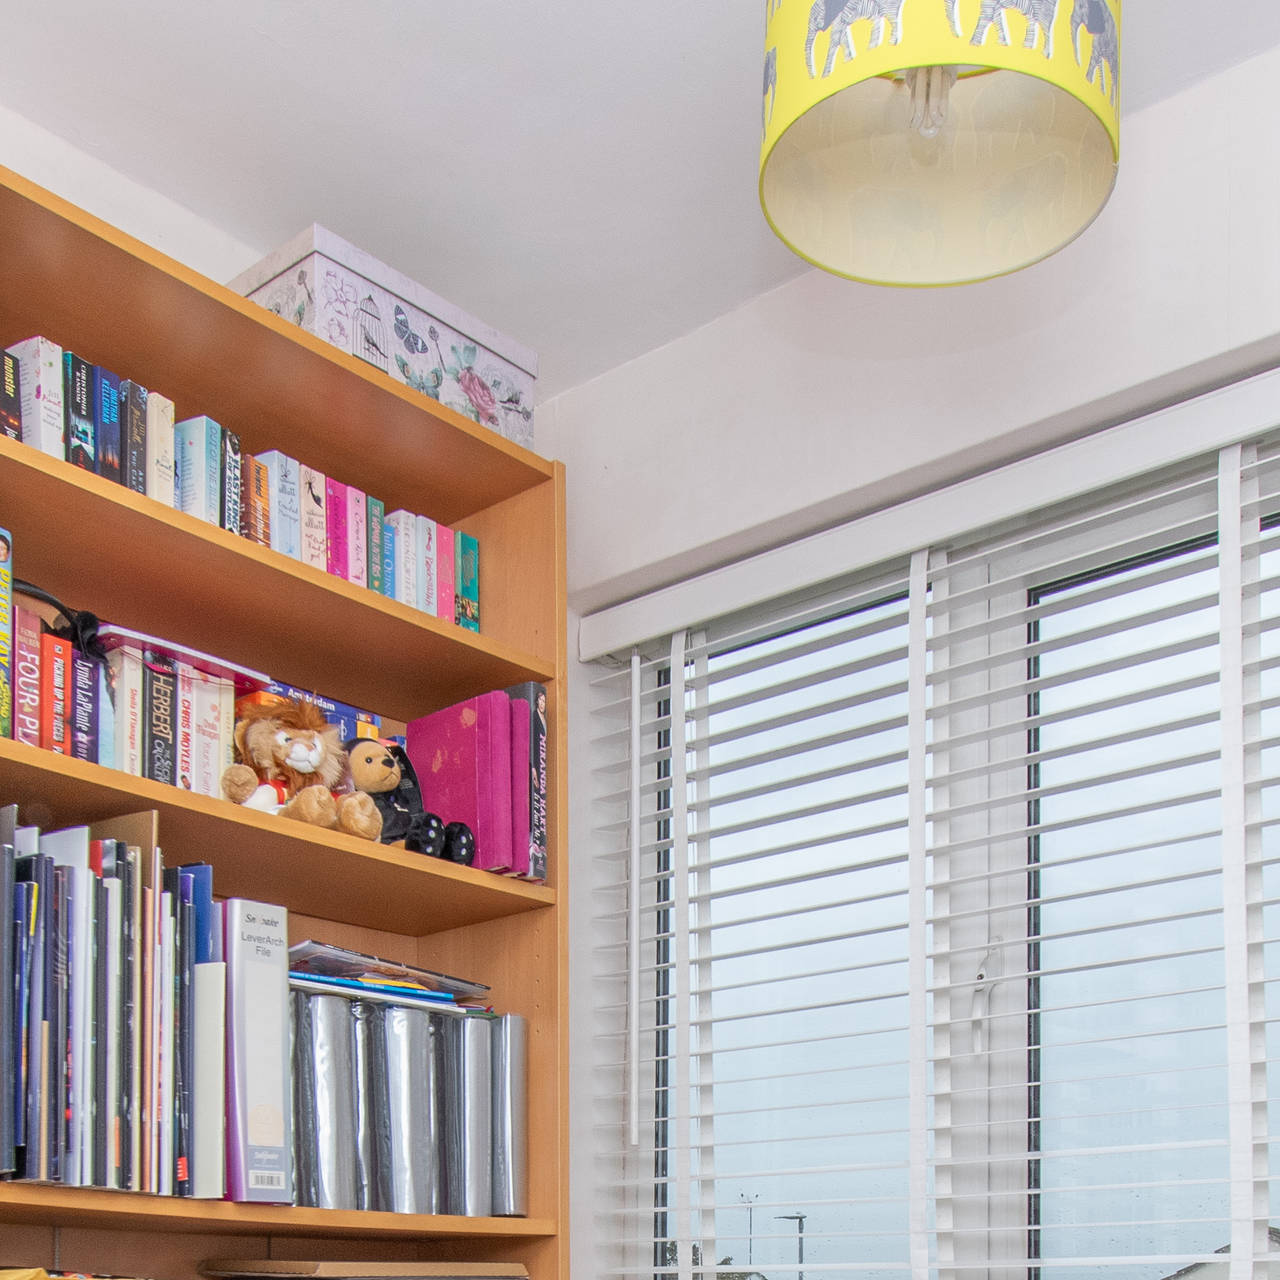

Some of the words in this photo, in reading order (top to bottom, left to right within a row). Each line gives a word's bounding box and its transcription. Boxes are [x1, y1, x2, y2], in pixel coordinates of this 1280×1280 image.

[4, 356, 16, 398] monster
[101, 378, 111, 424] KELLERMAN
[109, 386, 118, 423] JONATHAN
[209, 425, 218, 446] OUT
[232, 463, 240, 498] LAST
[254, 465, 263, 498] twisted
[232, 499, 240, 531] KING
[384, 531, 393, 554] Julia
[18, 649, 39, 706] FOUR
[53, 657, 64, 687] PICKING
[75, 660, 93, 689] Lynda
[53, 688, 64, 700] UP
[53, 701, 64, 714] THE
[152, 672, 173, 745] HERBERT
[287, 687, 336, 712] Amtrdam
[53, 715, 64, 742] PIECES
[181, 699, 191, 728] CHRIS
[128, 711, 138, 750] O'Flanagan
[180, 731, 191, 773] MOYLES
[539, 733, 547, 795] MIRANDA
[533, 792, 540, 801] Is
[539, 797, 547, 835] HART
[256, 945, 271, 957] File
